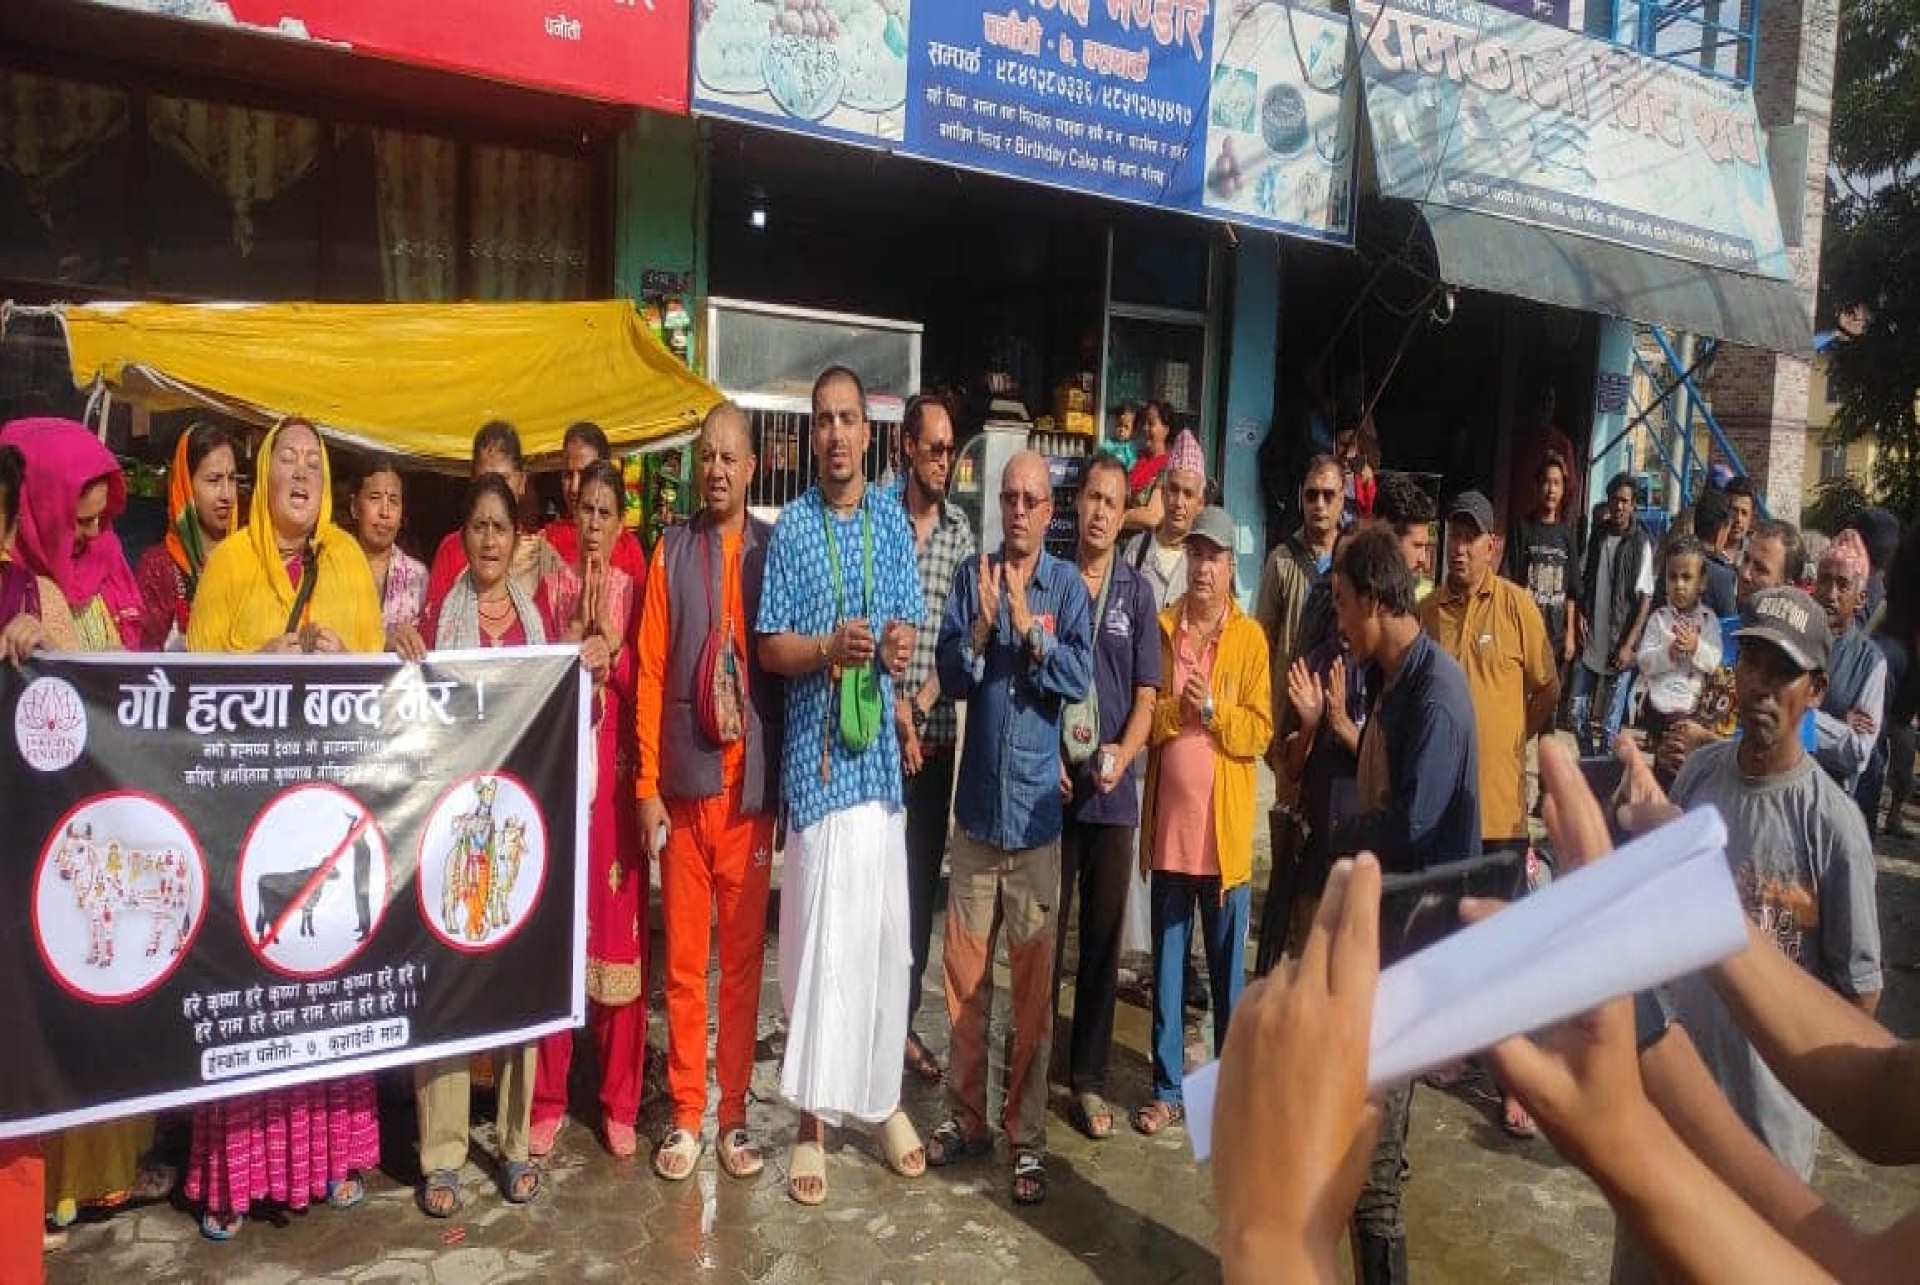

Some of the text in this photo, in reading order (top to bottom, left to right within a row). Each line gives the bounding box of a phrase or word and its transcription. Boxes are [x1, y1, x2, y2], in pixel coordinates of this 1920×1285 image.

[1015, 135, 1067, 168] Birthday
[1069, 147, 1099, 172] Cake
[117, 667, 176, 730] गौ
[185, 684, 293, 734] हत्या
[303, 683, 385, 729] बन्द
[183, 991, 202, 1019] हरे
[245, 983, 264, 1009] हरे
[376, 965, 394, 989] हरे
[397, 960, 416, 986] हरे
[194, 1018, 213, 1044] हरे
[217, 1017, 244, 1039] राम
[248, 1010, 267, 1034] हरे
[270, 1007, 297, 1031] राम
[300, 1004, 325, 1025] राम
[328, 1000, 354, 1021] राम
[359, 992, 376, 1017] हरे
[380, 990, 398, 1014] हरे
